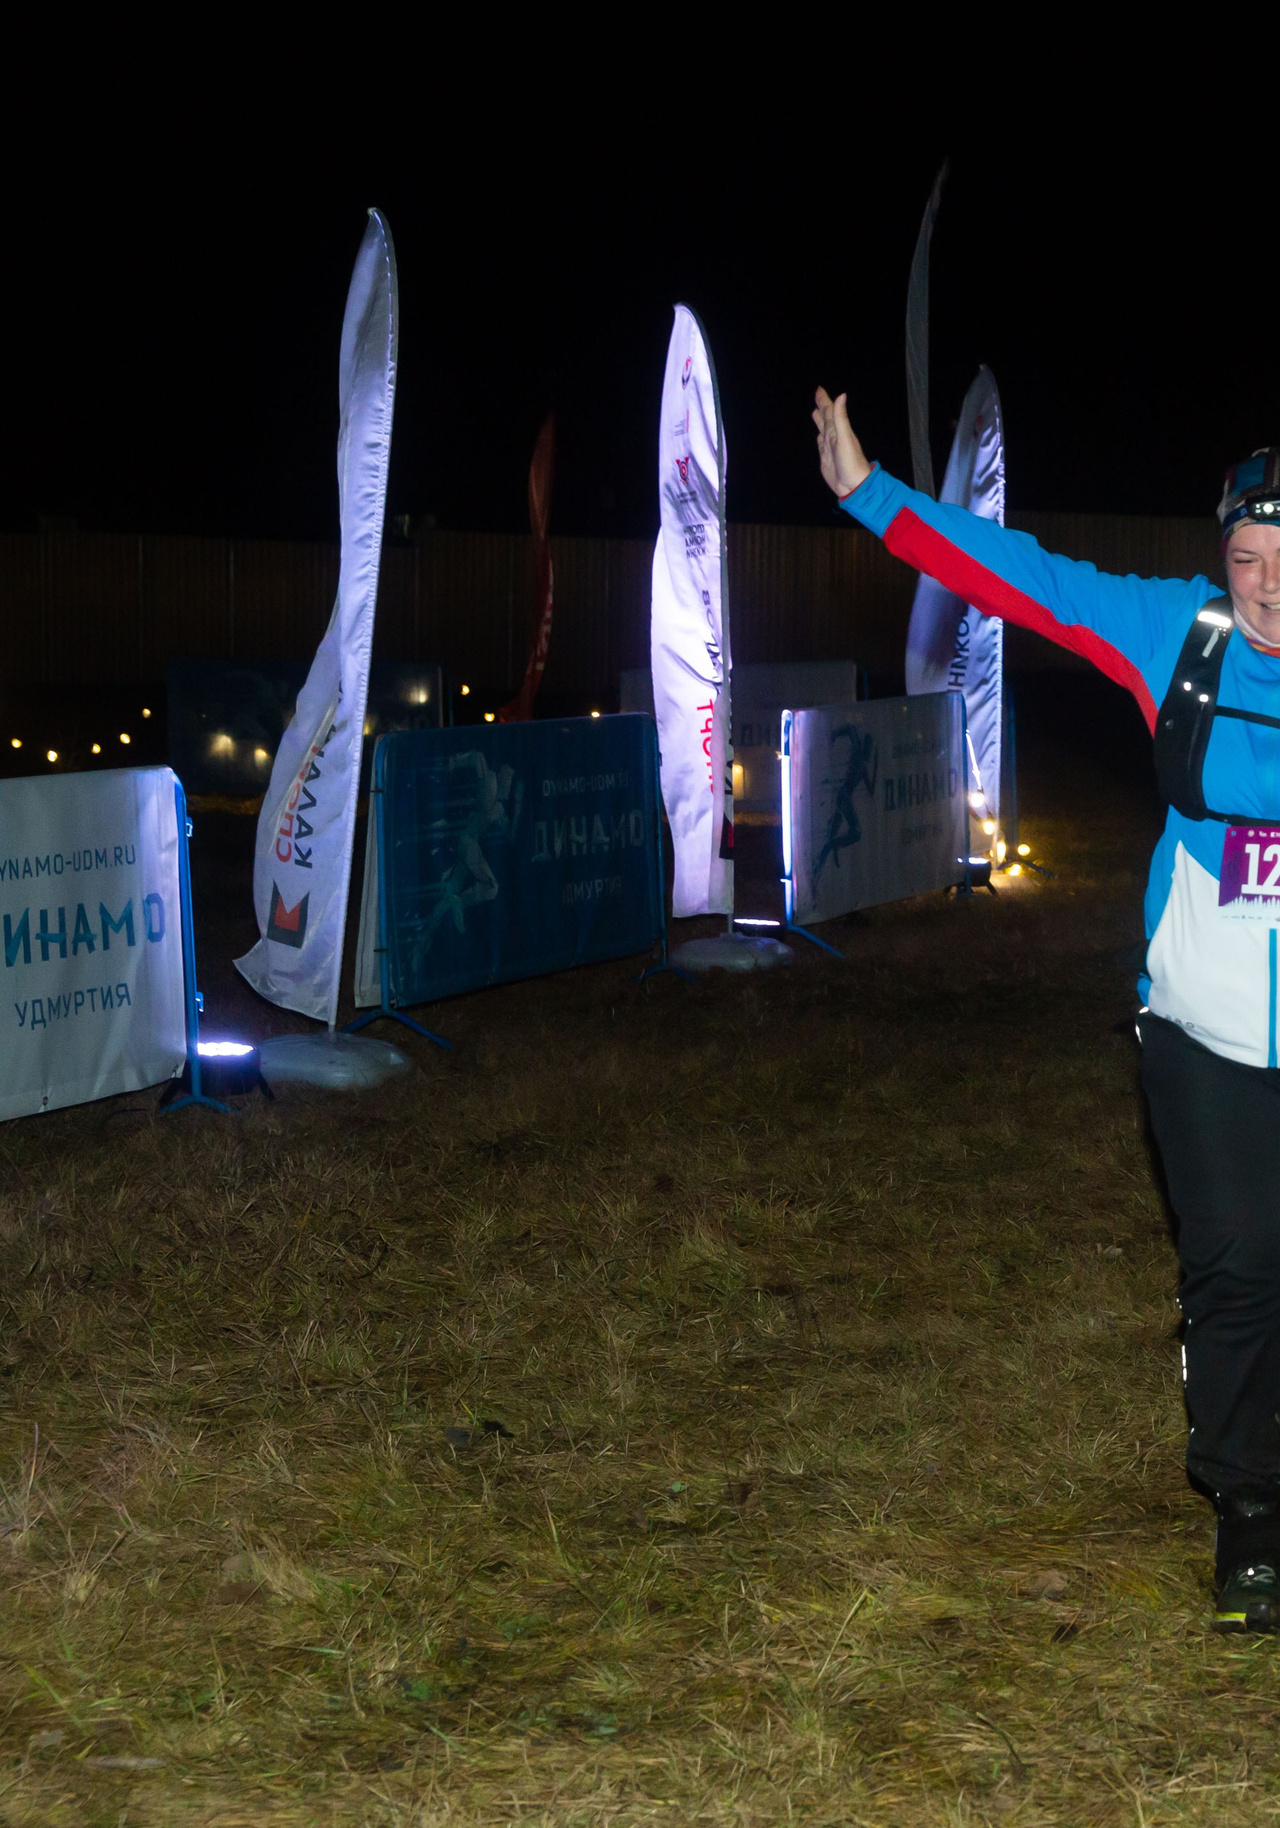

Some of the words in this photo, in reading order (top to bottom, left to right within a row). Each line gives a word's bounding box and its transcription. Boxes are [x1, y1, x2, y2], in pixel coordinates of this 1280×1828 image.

[541, 769, 629, 797] DYNAMO-UDMRU
[530, 808, 645, 862] ДИНАМО
[0, 844, 137, 882] YNAMO-UDM.RU
[561, 875, 622, 907] ДМУРТИЯ
[2, 892, 165, 968] ИНАМО
[14, 982, 132, 1031] УДМУРТИЯ
